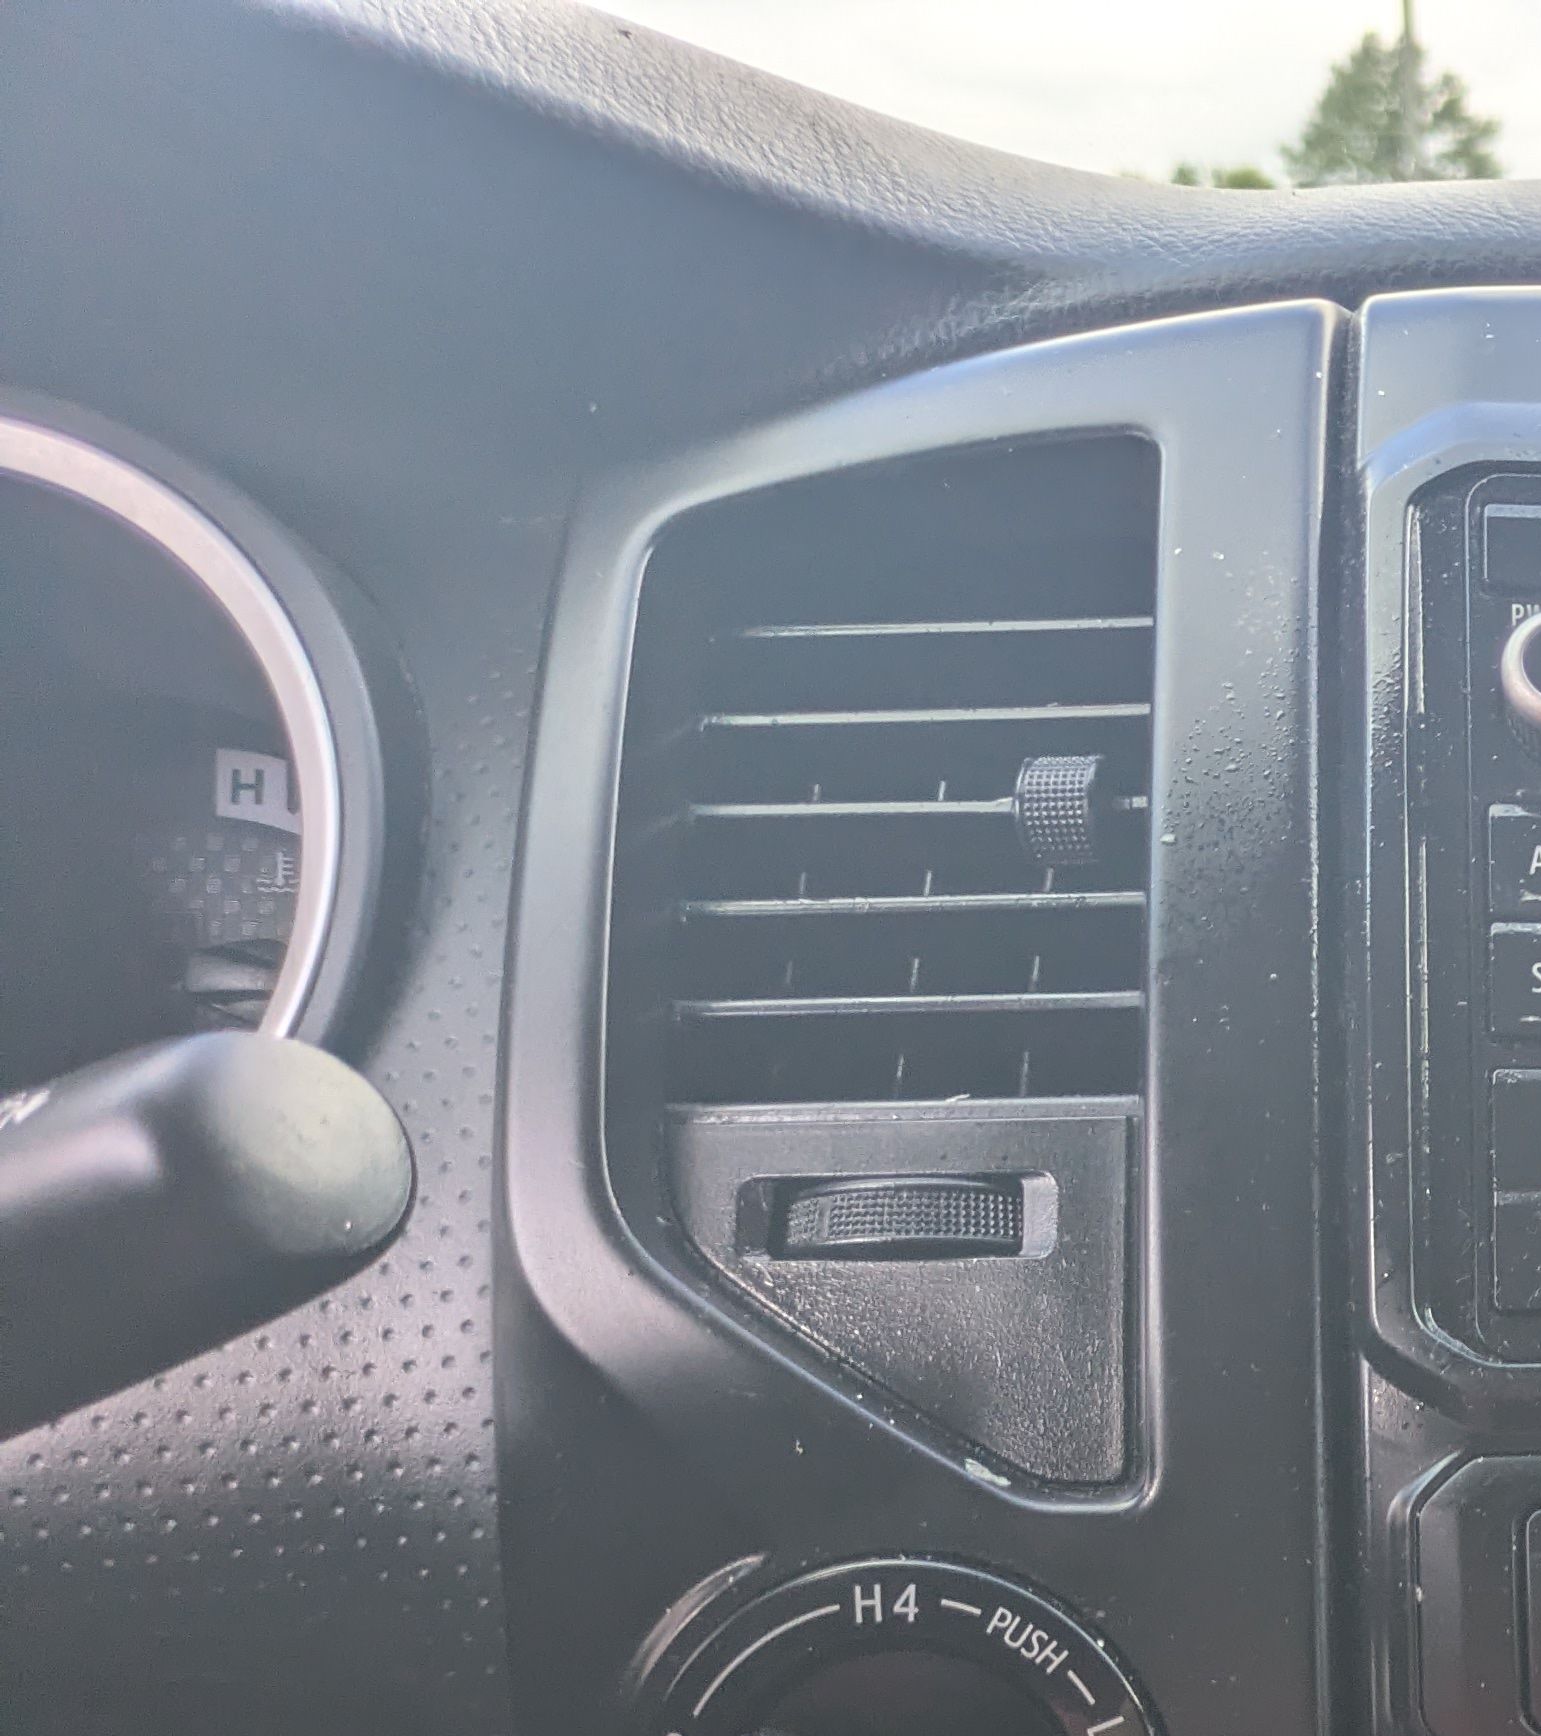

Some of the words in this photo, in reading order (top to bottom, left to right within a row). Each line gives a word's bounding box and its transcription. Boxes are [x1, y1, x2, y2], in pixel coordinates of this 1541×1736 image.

[231, 768, 264, 805] H
[854, 1584, 920, 1624] H4
[986, 1606, 1069, 1674] PUSH
